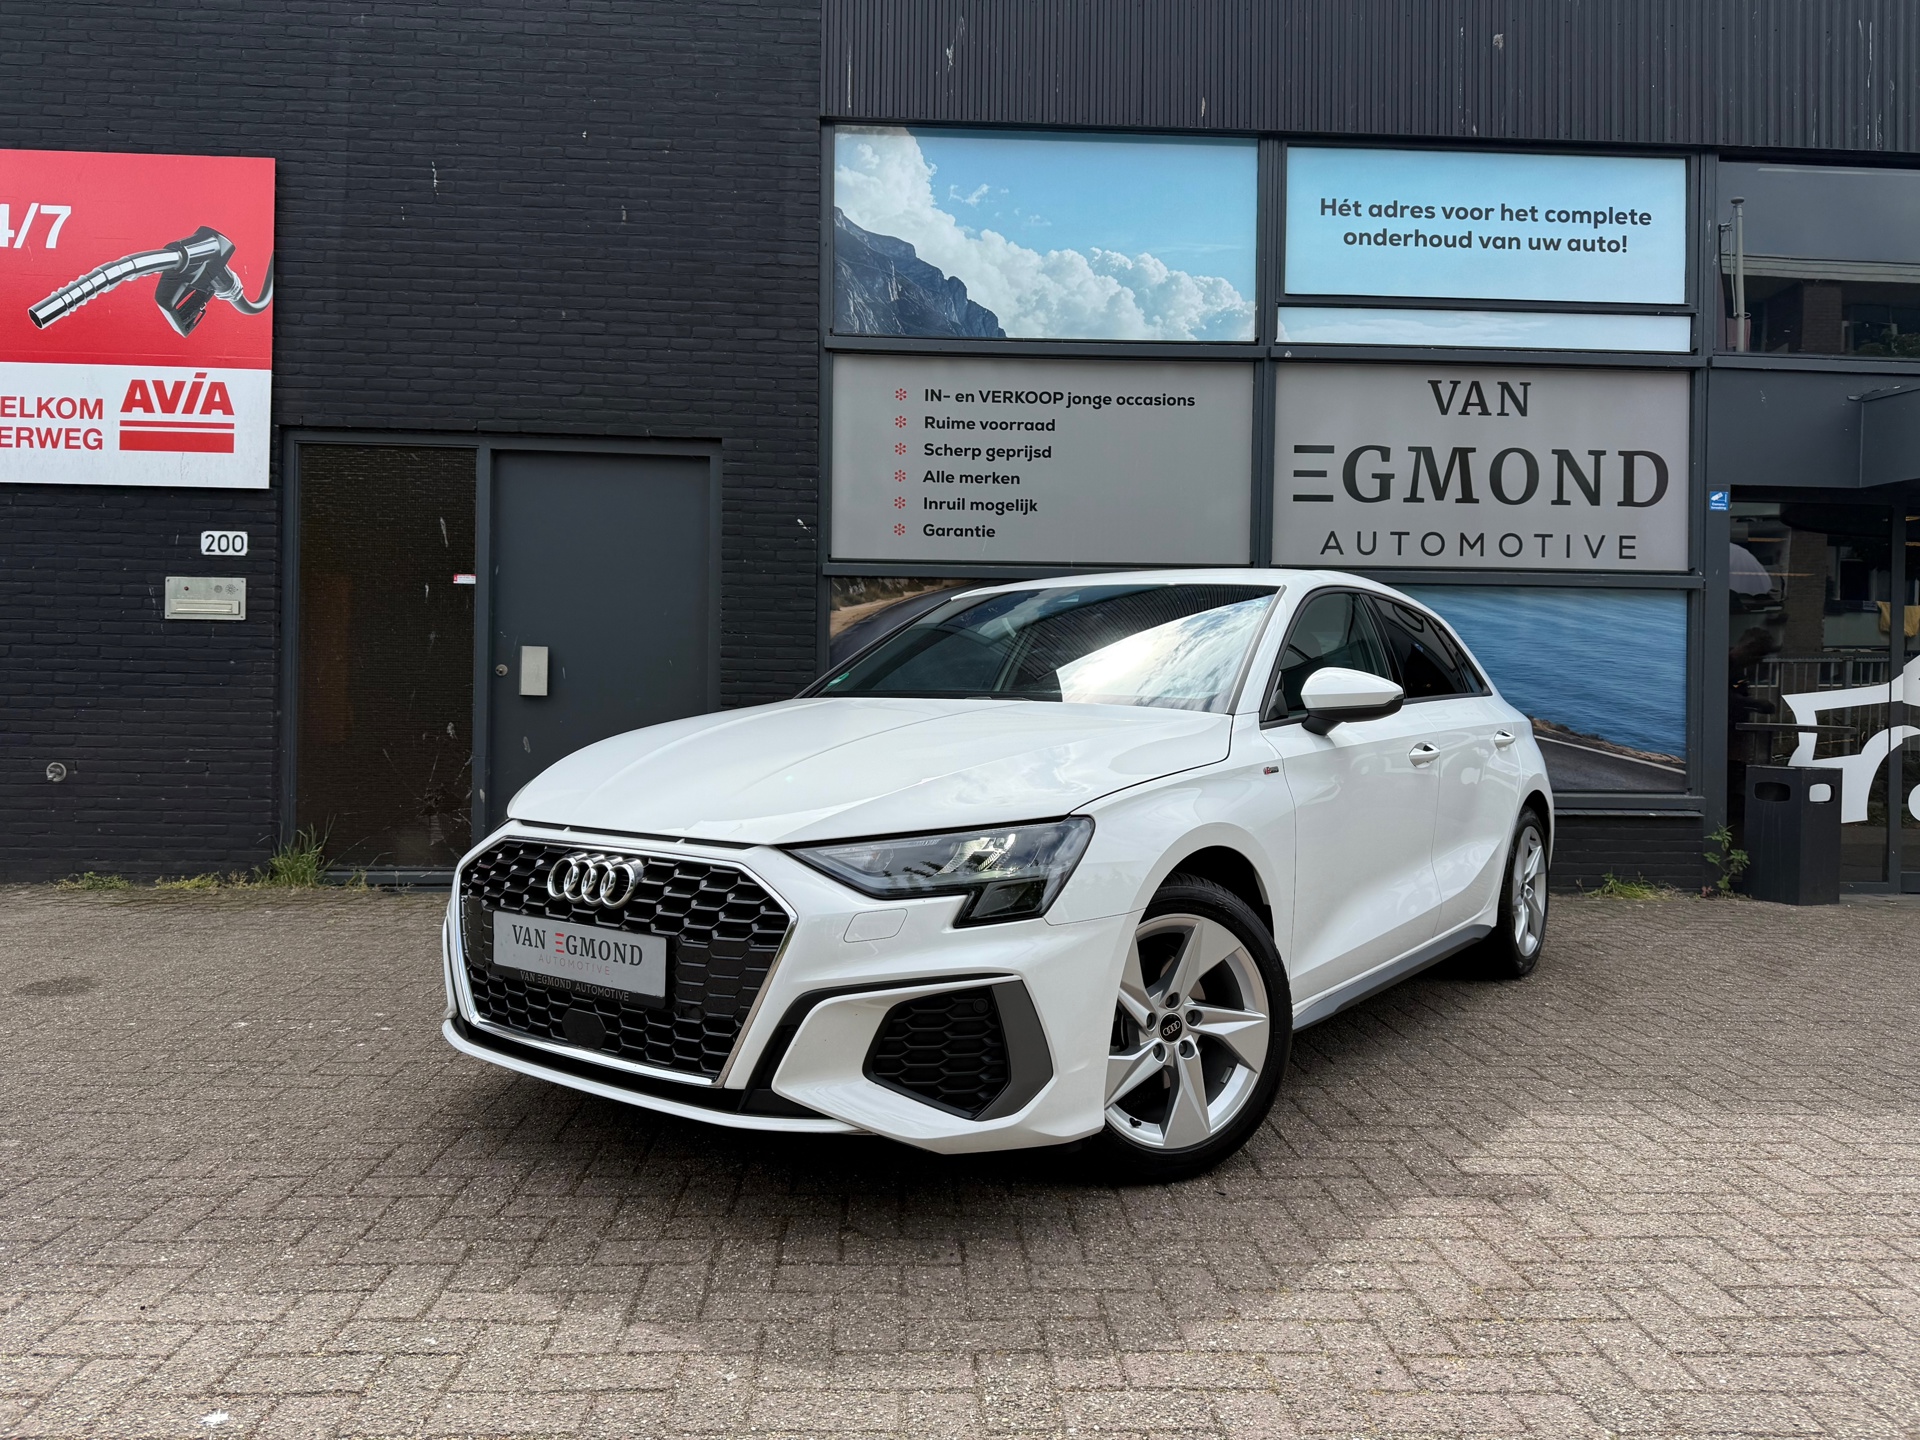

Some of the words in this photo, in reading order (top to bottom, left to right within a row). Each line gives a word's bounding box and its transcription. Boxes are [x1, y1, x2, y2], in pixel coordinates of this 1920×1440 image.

[1320, 198, 1362, 217] Hét
[1368, 200, 1436, 219] adres
[1441, 206, 1495, 221] voor
[1500, 203, 1539, 223] het
[1544, 206, 1652, 229] complete
[1343, 228, 1472, 249] onderhoud
[1478, 235, 1521, 250] van
[1528, 237, 1562, 251] uw
[1567, 235, 1627, 253] auto!
[924, 388, 951, 402] IN-
[954, 392, 975, 403] en
[978, 389, 1065, 405] VERKOOP
[1065, 391, 1113, 410] jonge
[1115, 392, 1196, 407] occasions
[1427, 379, 1532, 417] VAN
[924, 415, 976, 430] Ruime
[979, 418, 1056, 432] voorraad
[923, 442, 982, 461] Scherp
[985, 444, 1052, 462] geprijsd
[922, 470, 955, 484] Alle
[959, 471, 1021, 485] merken
[1292, 444, 1669, 508] EGMOND
[923, 496, 966, 511] Inruil
[969, 498, 1038, 516] mogelijk
[922, 523, 996, 538] Garantie
[205, 533, 245, 553] 200
[1319, 530, 1637, 560] AUTOMOTIVE
[512, 925, 546, 949] VAN
[555, 932, 643, 967] EGMOND
[538, 953, 611, 975] AUTOMOTIVE
[519, 970, 536, 983] VAN
[536, 974, 572, 990] EGMOND
[575, 982, 630, 1002] AUTOMOTIVE
